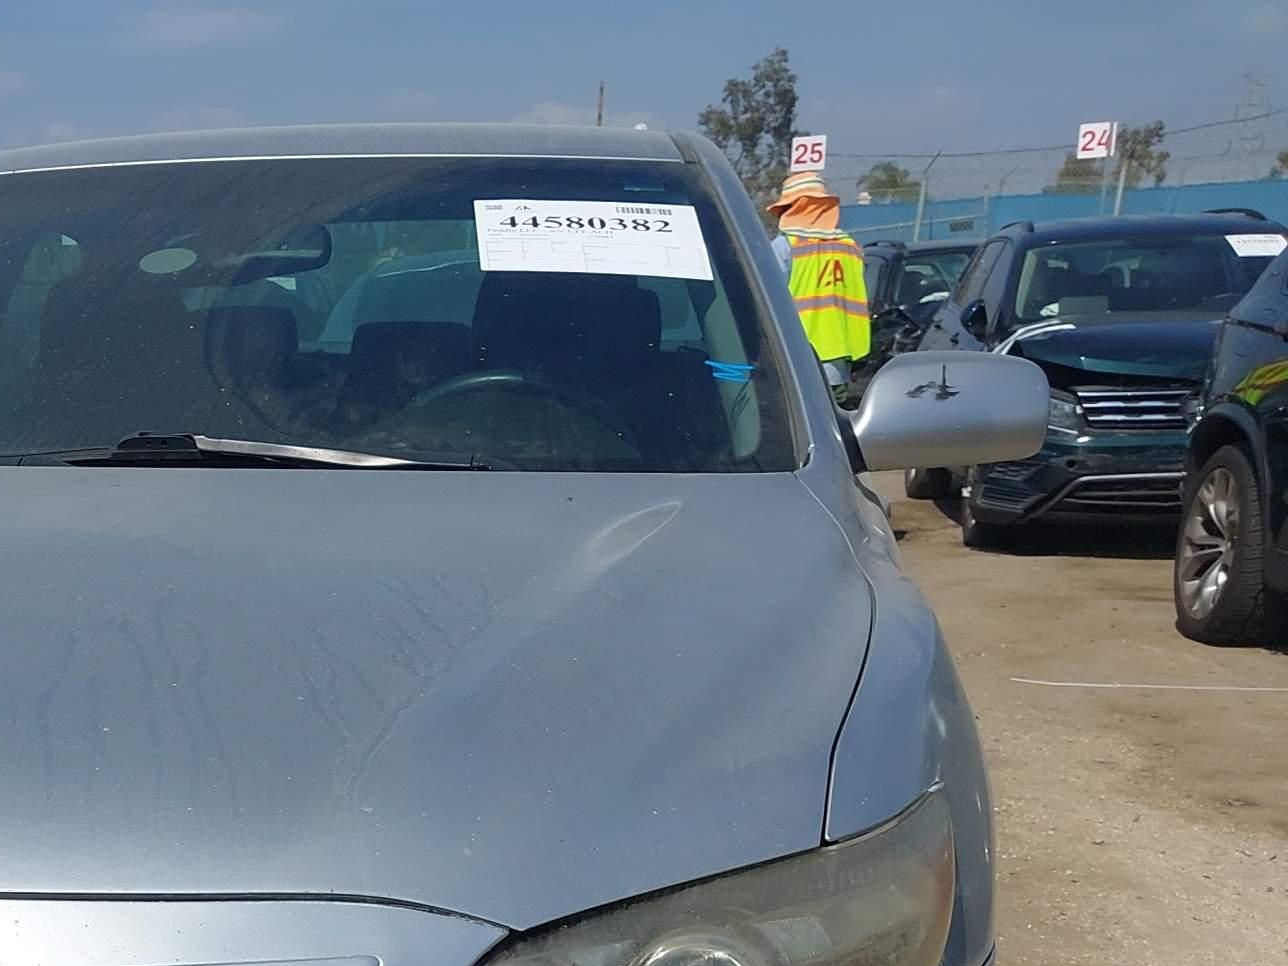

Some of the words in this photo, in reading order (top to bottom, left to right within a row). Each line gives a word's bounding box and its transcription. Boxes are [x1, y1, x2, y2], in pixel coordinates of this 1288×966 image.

[1081, 129, 1111, 152] 24
[794, 142, 823, 164] 25
[499, 215, 673, 233] 44580382
